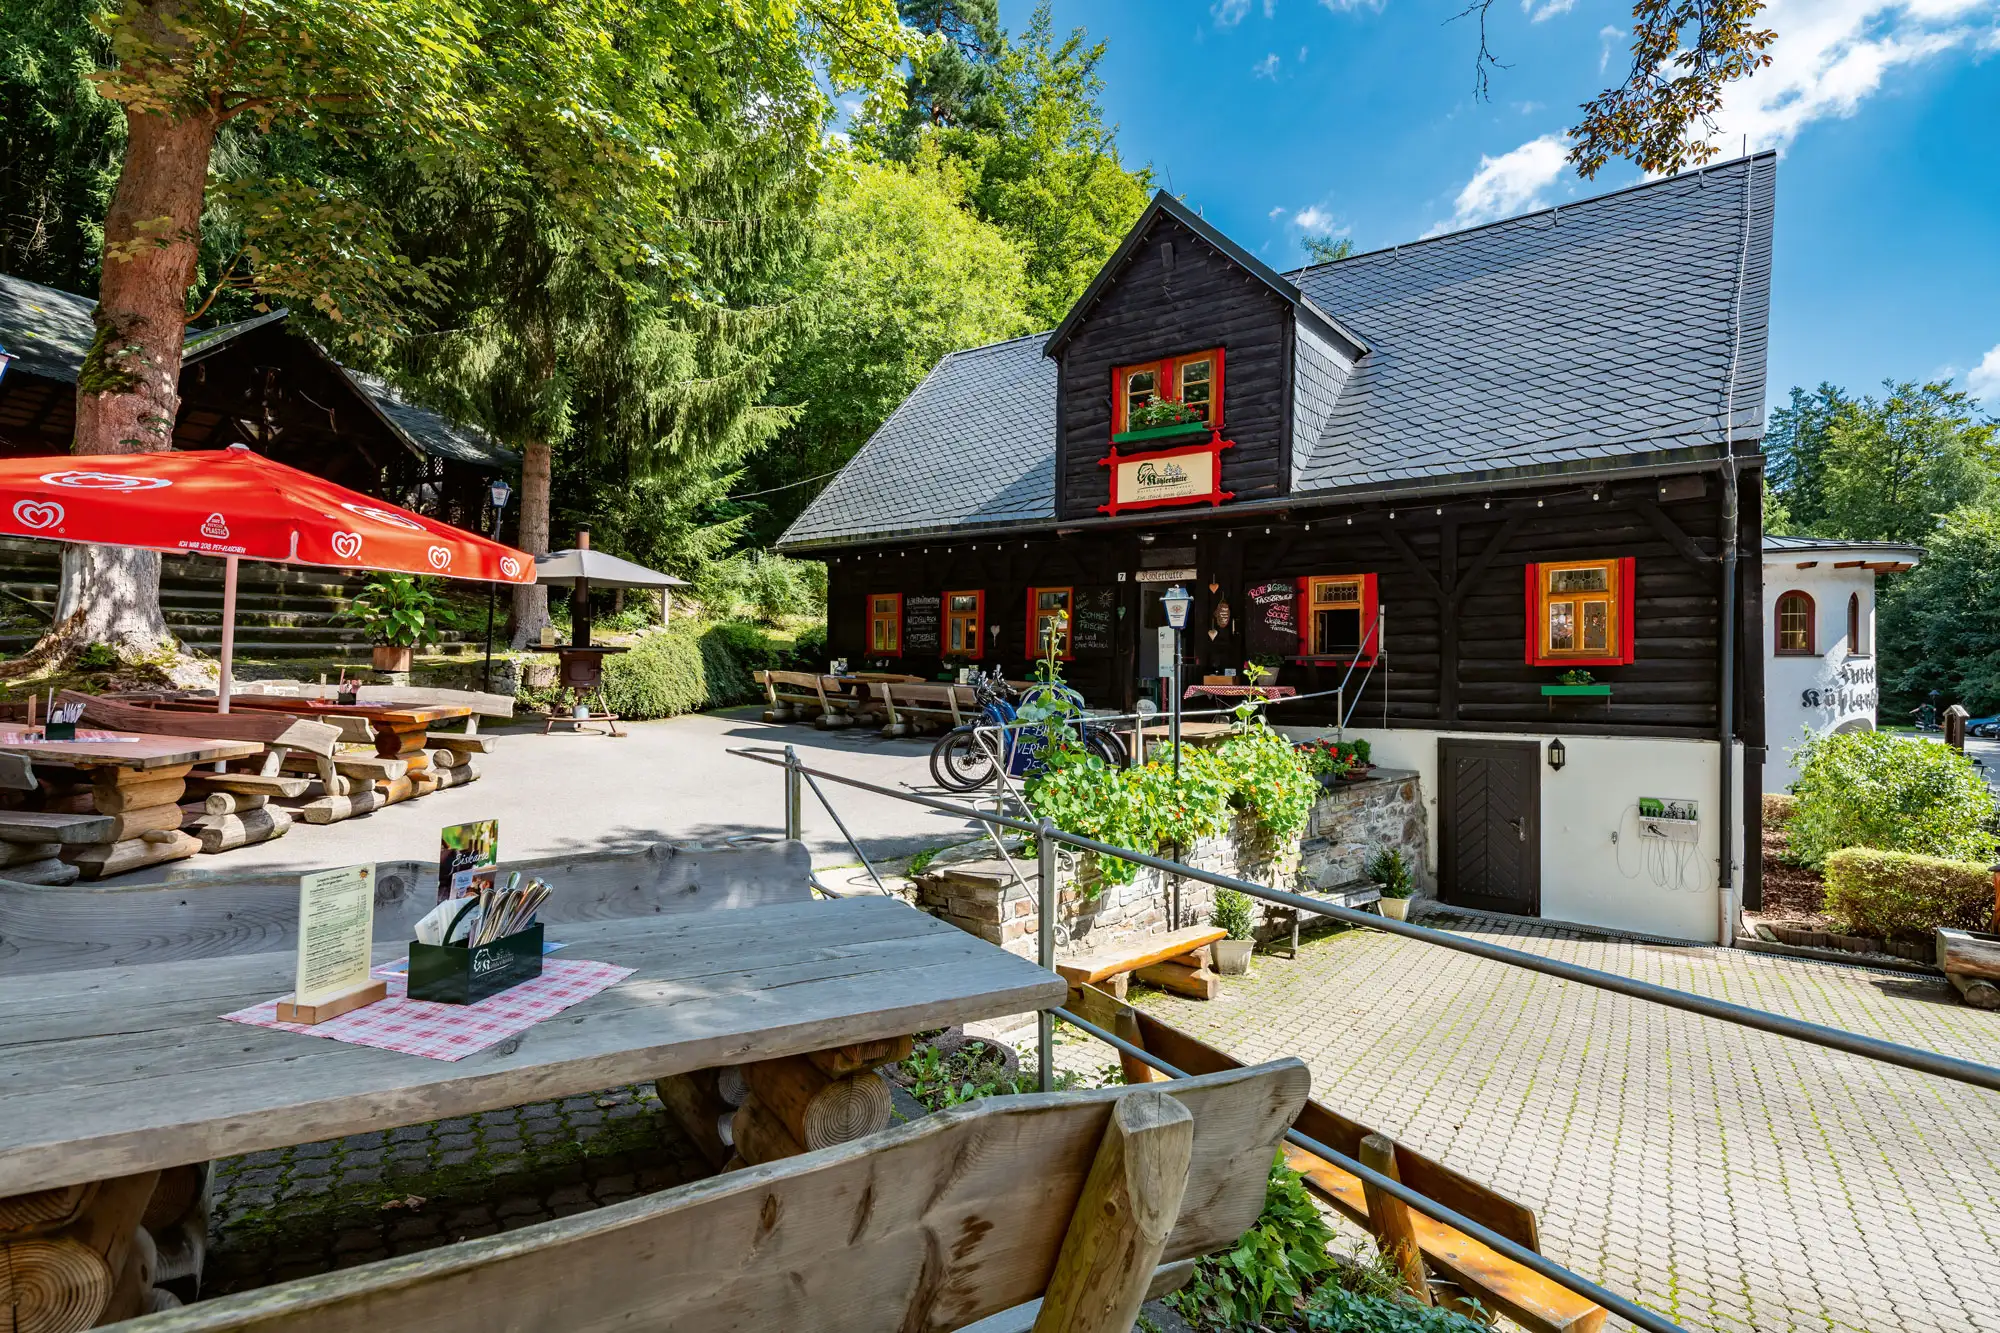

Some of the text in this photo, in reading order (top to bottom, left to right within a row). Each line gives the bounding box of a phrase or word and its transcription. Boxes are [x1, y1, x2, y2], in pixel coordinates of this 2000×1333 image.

[206, 527, 226, 535] PLASTIC
[1248, 585, 1267, 599] ROTE
[1270, 602, 1290, 613] ROTE
[1266, 608, 1289, 621] SOCKE
[451, 849, 490, 868] Eiskarte
